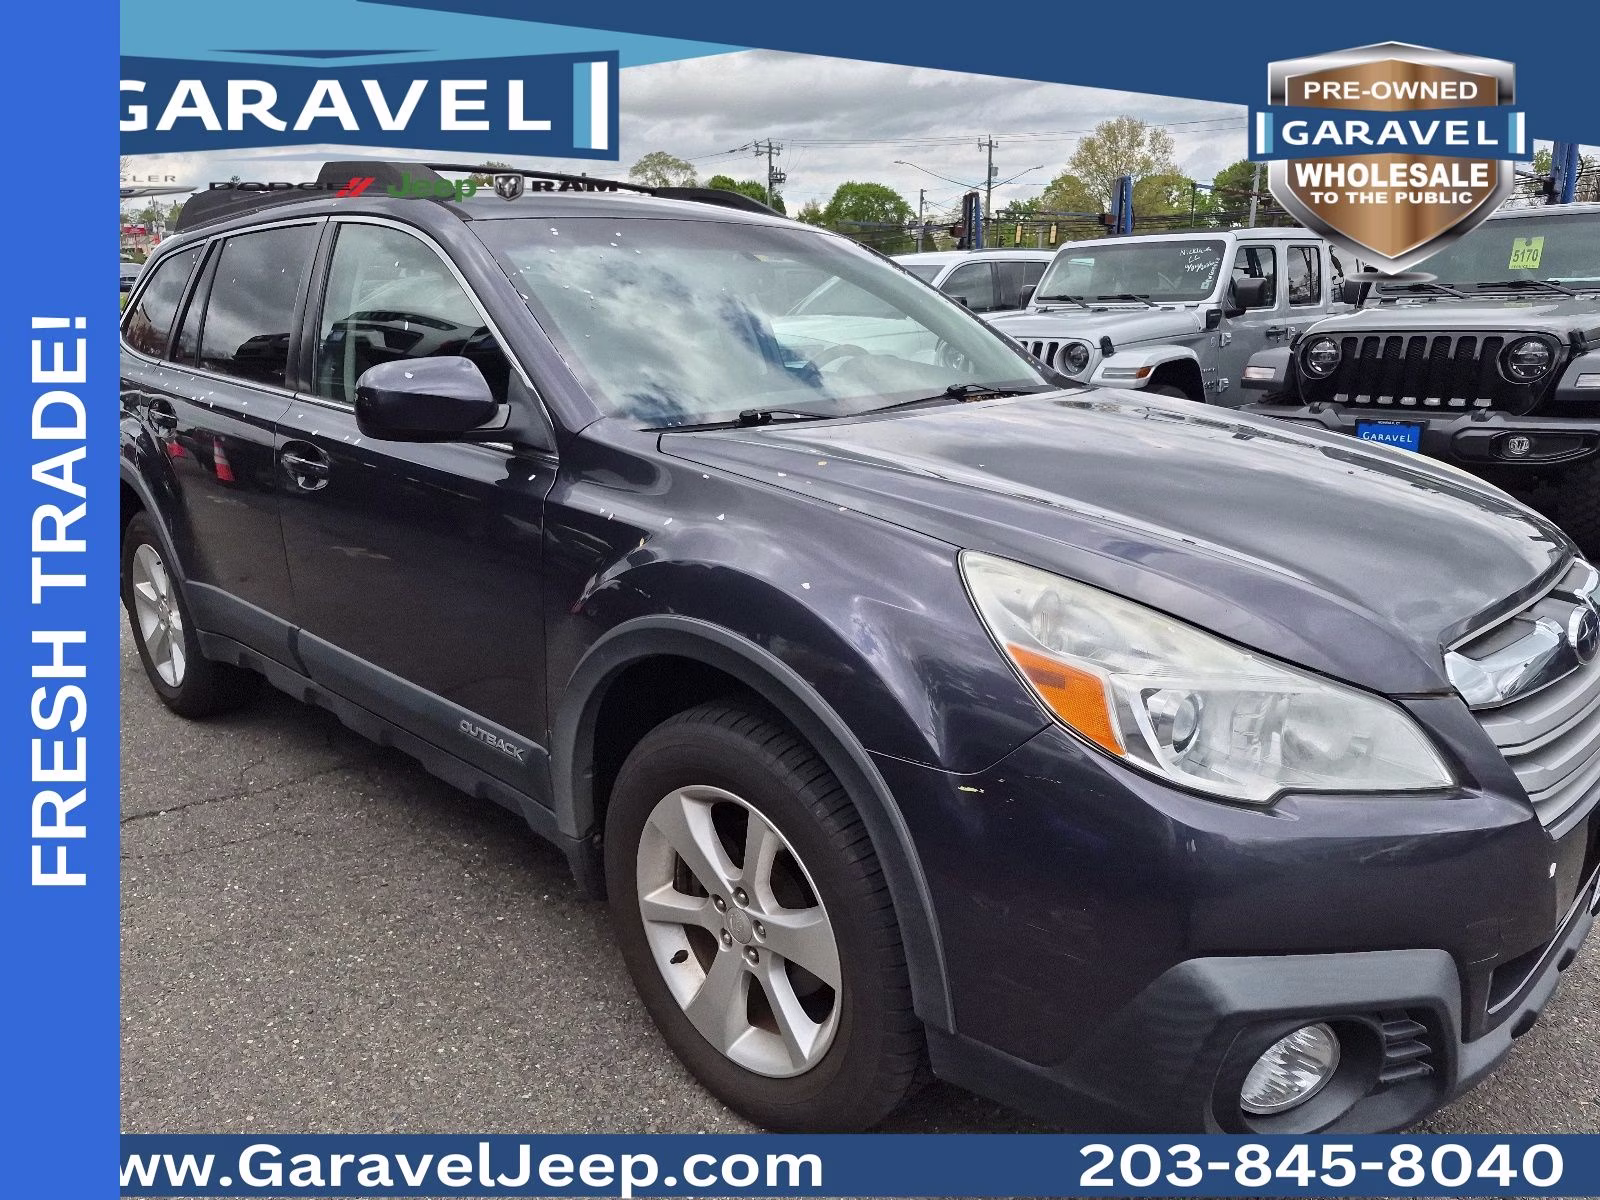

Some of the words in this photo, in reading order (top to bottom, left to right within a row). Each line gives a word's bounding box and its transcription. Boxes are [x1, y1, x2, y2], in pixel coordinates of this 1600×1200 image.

[1513, 249, 1539, 262] 5170
[1362, 431, 1413, 443] GARAVEL
[460, 719, 525, 761] OUTBACK
